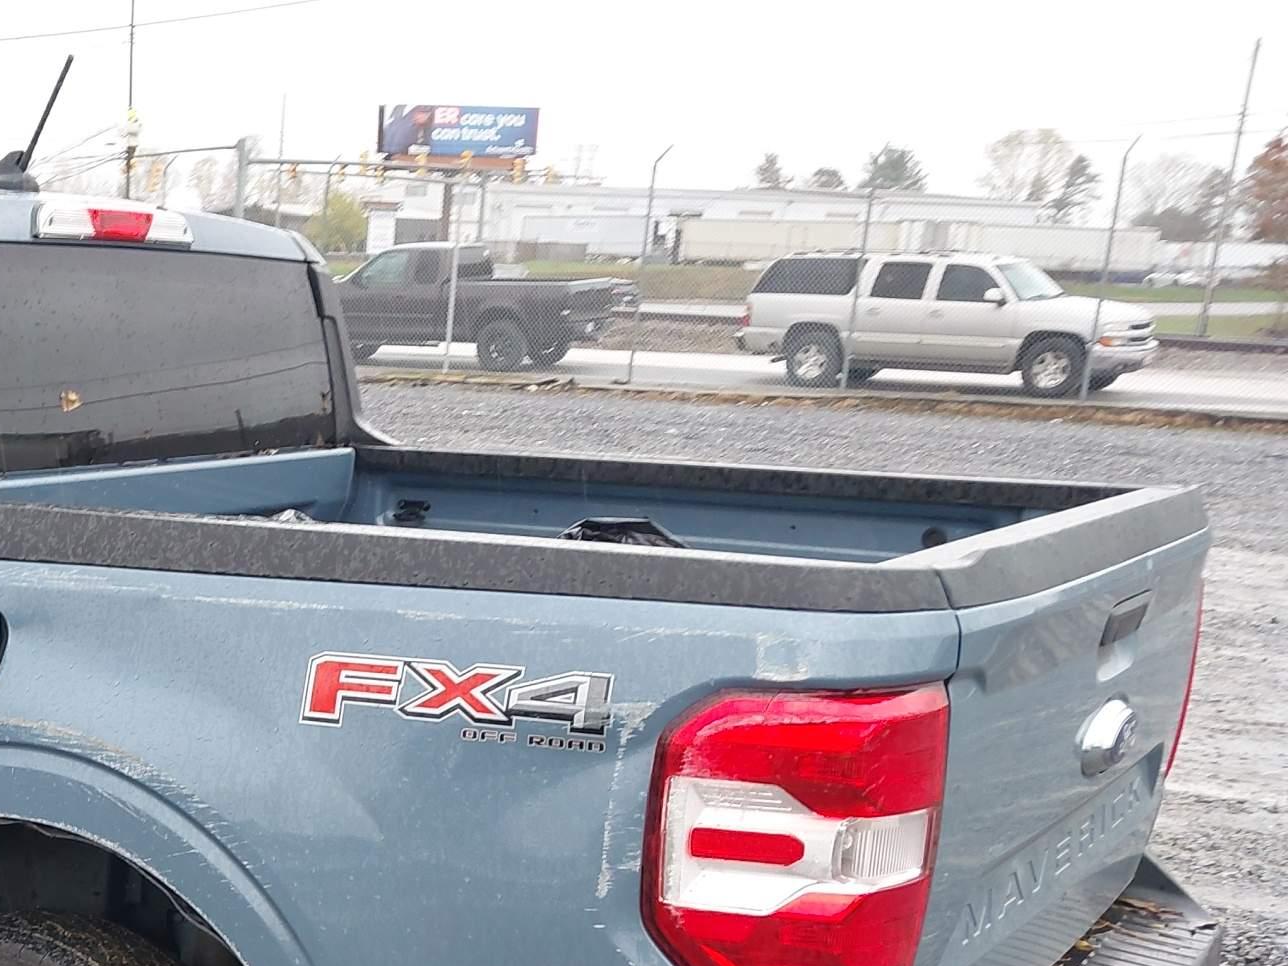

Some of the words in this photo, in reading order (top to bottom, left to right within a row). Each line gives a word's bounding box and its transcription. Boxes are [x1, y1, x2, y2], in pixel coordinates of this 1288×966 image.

[431, 127, 460, 141] can
[460, 113, 495, 127] care
[497, 113, 526, 130] you
[298, 650, 615, 737] FX4
[460, 726, 519, 744] OFF
[526, 734, 608, 753] ROAD
[960, 774, 1144, 947] MAVERICK
